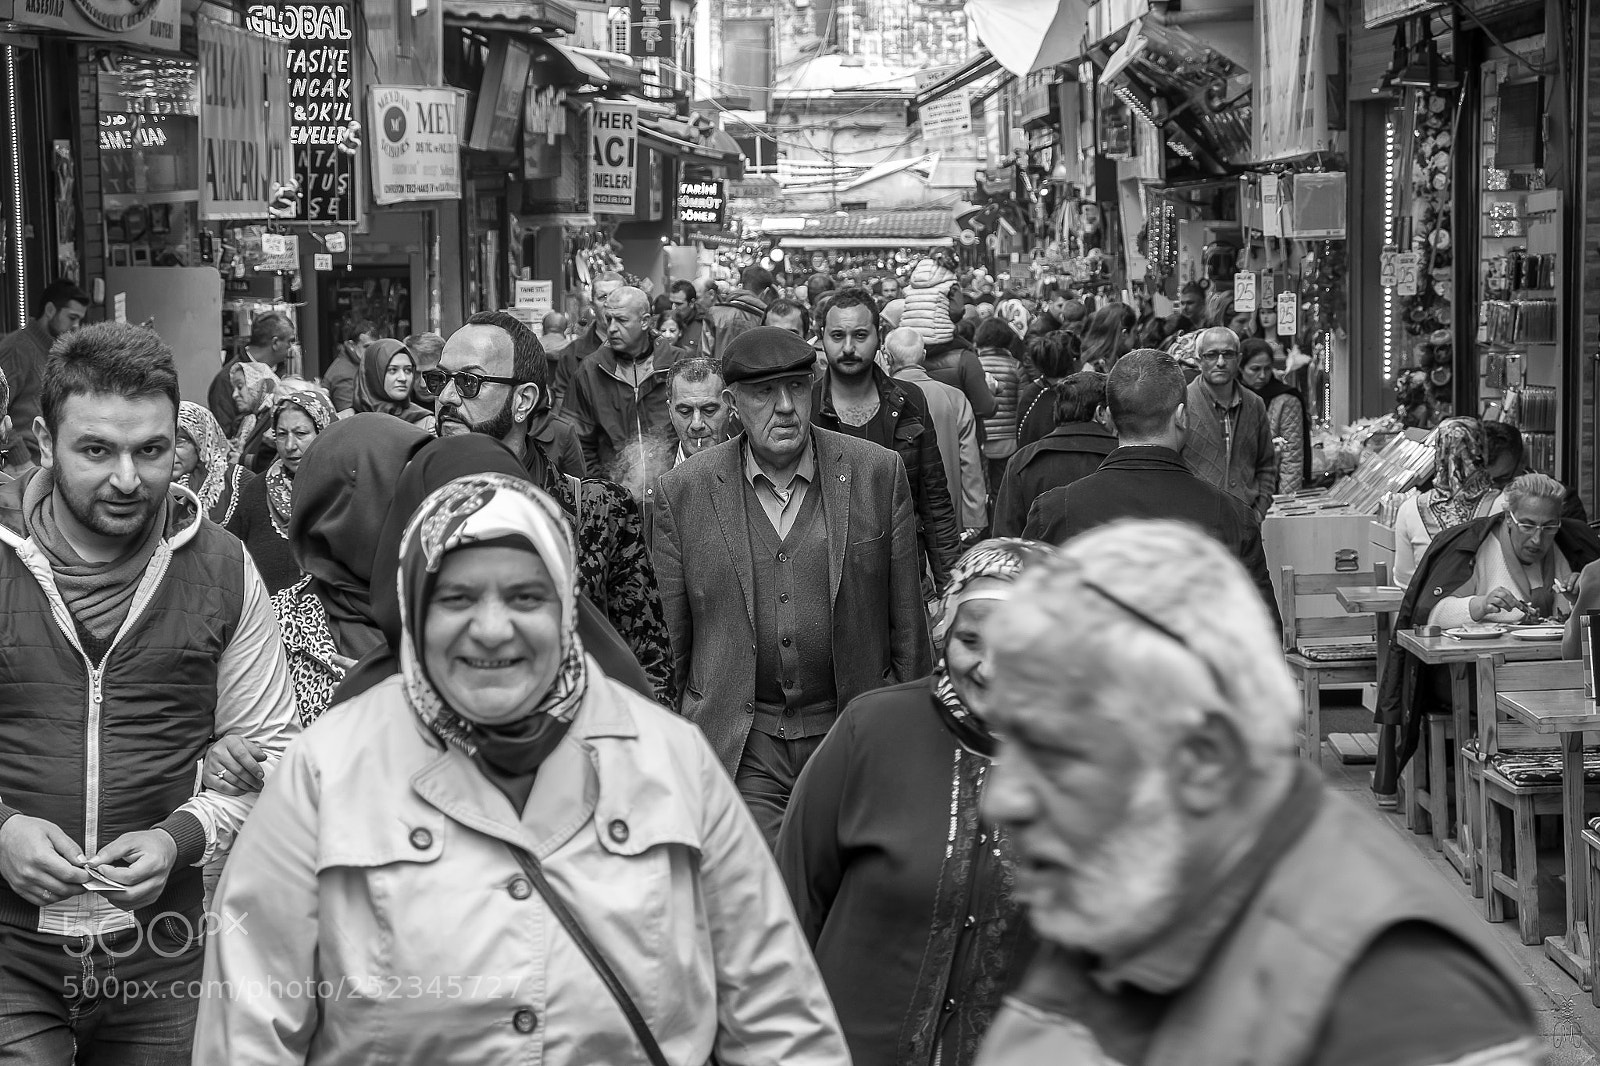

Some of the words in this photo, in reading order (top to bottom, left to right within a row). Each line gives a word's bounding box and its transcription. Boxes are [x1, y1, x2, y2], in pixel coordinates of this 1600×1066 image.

[246, 5, 352, 40] GLOBAL
[287, 78, 351, 98] NCAK
[1235, 282, 1255, 302] 25
